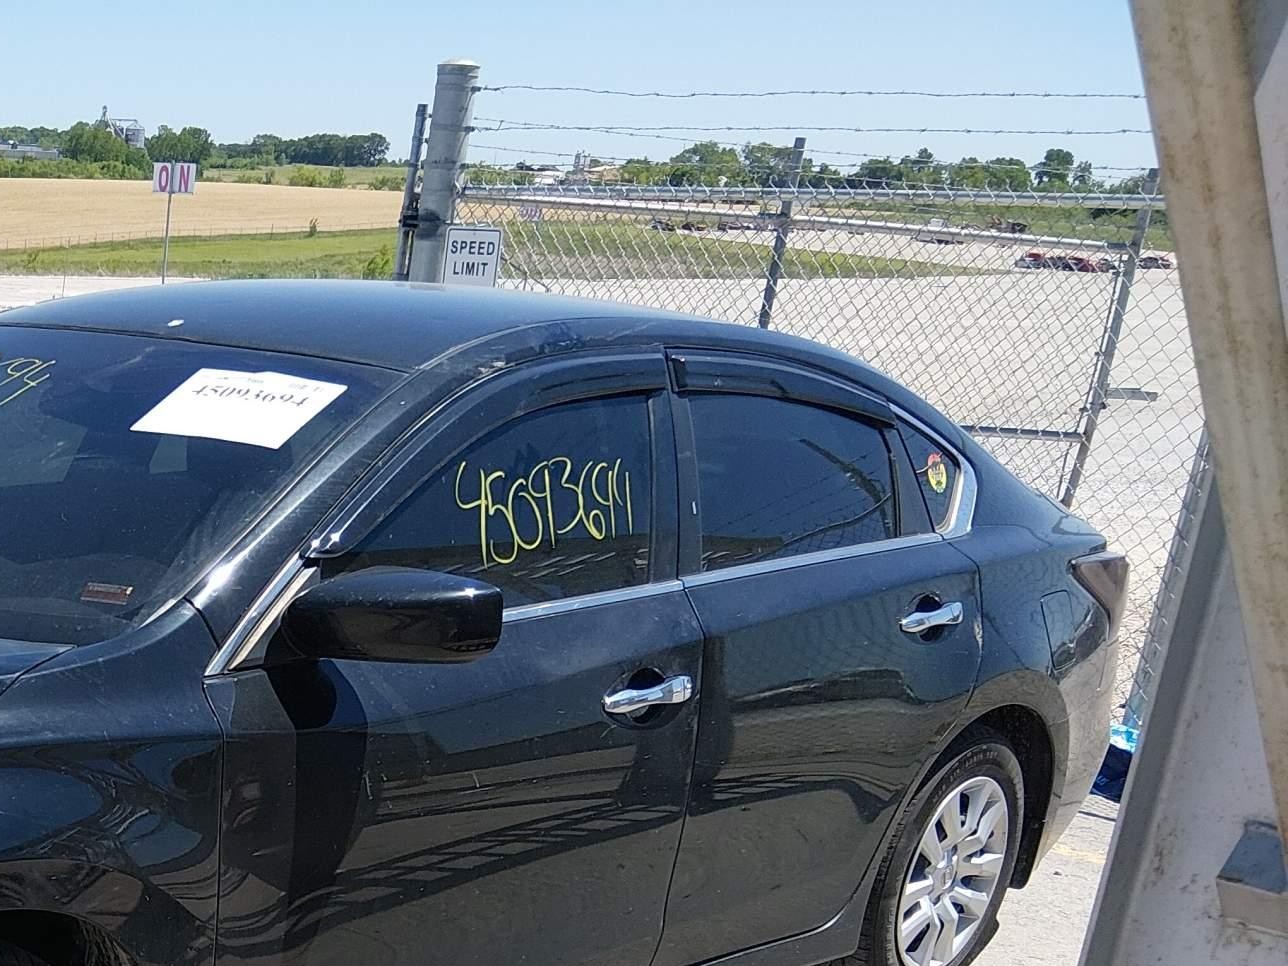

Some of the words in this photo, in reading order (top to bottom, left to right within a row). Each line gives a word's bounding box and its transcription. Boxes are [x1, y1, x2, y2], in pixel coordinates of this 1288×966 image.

[450, 240, 496, 256] SPEED
[452, 261, 489, 277] LIMIT
[455, 457, 633, 570] 45093694
